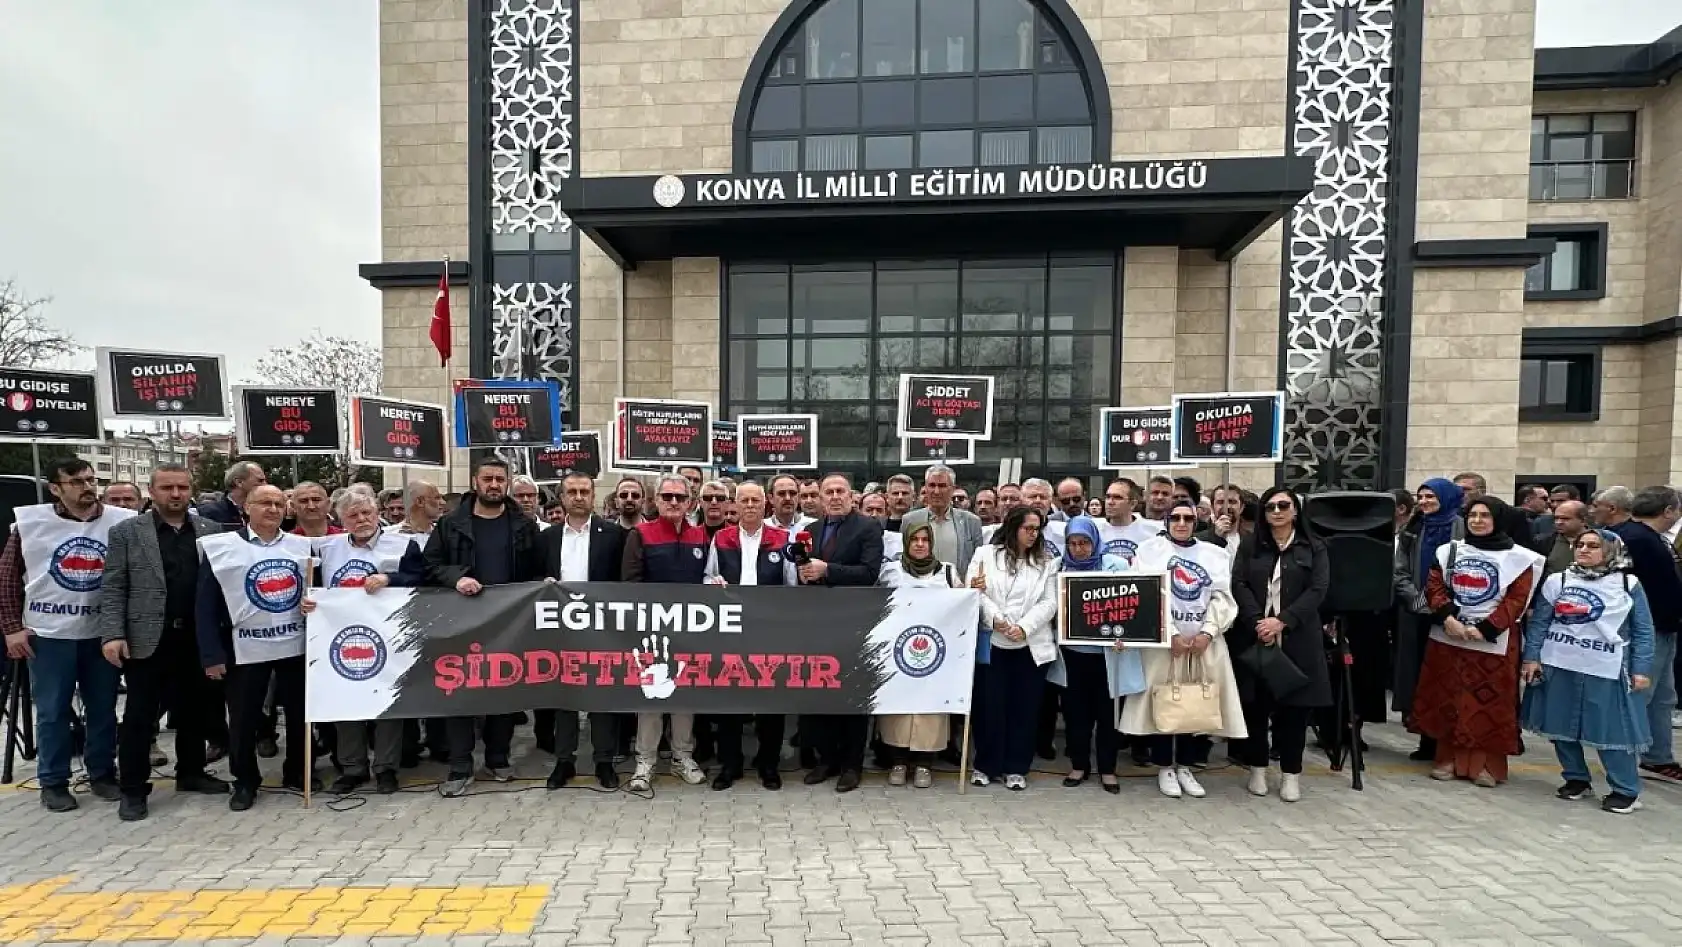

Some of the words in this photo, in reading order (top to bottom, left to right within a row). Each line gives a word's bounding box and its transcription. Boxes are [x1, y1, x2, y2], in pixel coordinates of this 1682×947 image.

[697, 178, 785, 201] KONYA
[797, 172, 819, 198] İL
[910, 169, 1005, 196] EĞİTİM
[1018, 161, 1207, 193] MÜDÜRLÜĞÜ
[131, 363, 196, 377] OKULDA
[925, 385, 972, 398] ŞİDDET
[35, 398, 88, 411] DİYELİM
[266, 396, 316, 407] NEREYE
[484, 394, 531, 404] NEREYE
[281, 406, 301, 418] BU
[380, 406, 425, 422] NEREYE
[499, 405, 518, 416] BU
[1195, 404, 1253, 421] OKULDA
[394, 419, 412, 432] BU
[1123, 419, 1138, 428] BU
[1111, 434, 1131, 443] DUR
[1221, 427, 1249, 440] NE?
[1082, 583, 1139, 601] OKULDA
[28, 601, 102, 616] MEMUR-
[534, 593, 743, 633] EĞİTİMDE
[1109, 608, 1136, 622] NE?
[238, 621, 306, 639] MEMUR-
[433, 642, 655, 694] ŞİDDETE
[673, 653, 841, 689] HAYIR
